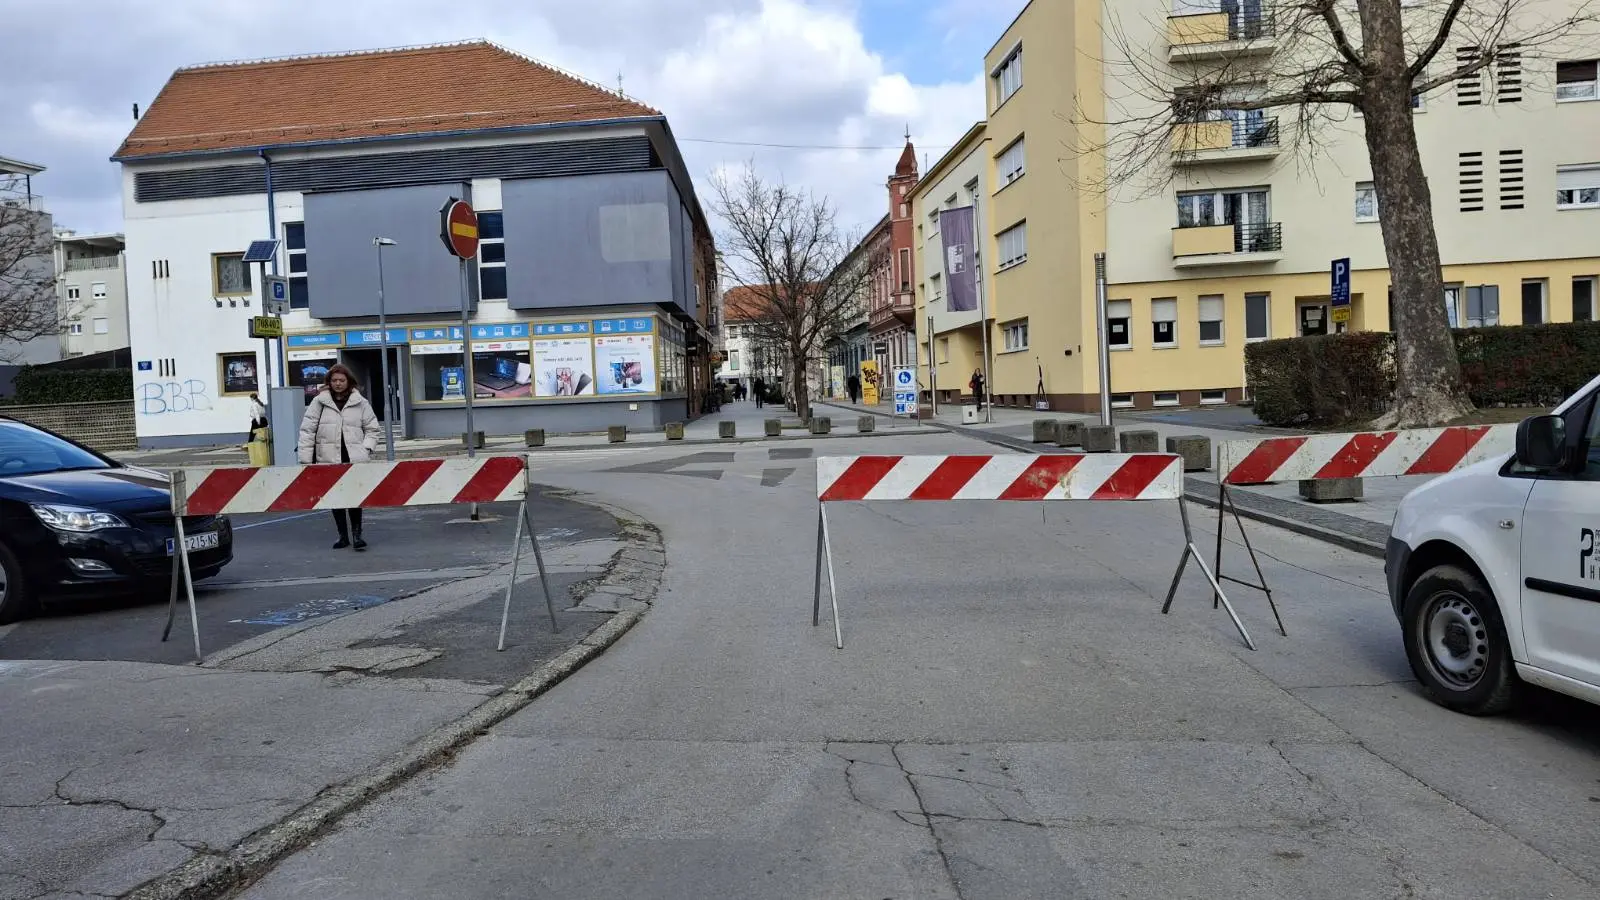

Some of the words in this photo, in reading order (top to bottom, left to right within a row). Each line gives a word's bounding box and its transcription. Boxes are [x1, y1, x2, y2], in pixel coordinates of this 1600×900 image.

[1335, 262, 1345, 285] P
[276, 285, 282, 296] P
[256, 318, 280, 330] 708402
